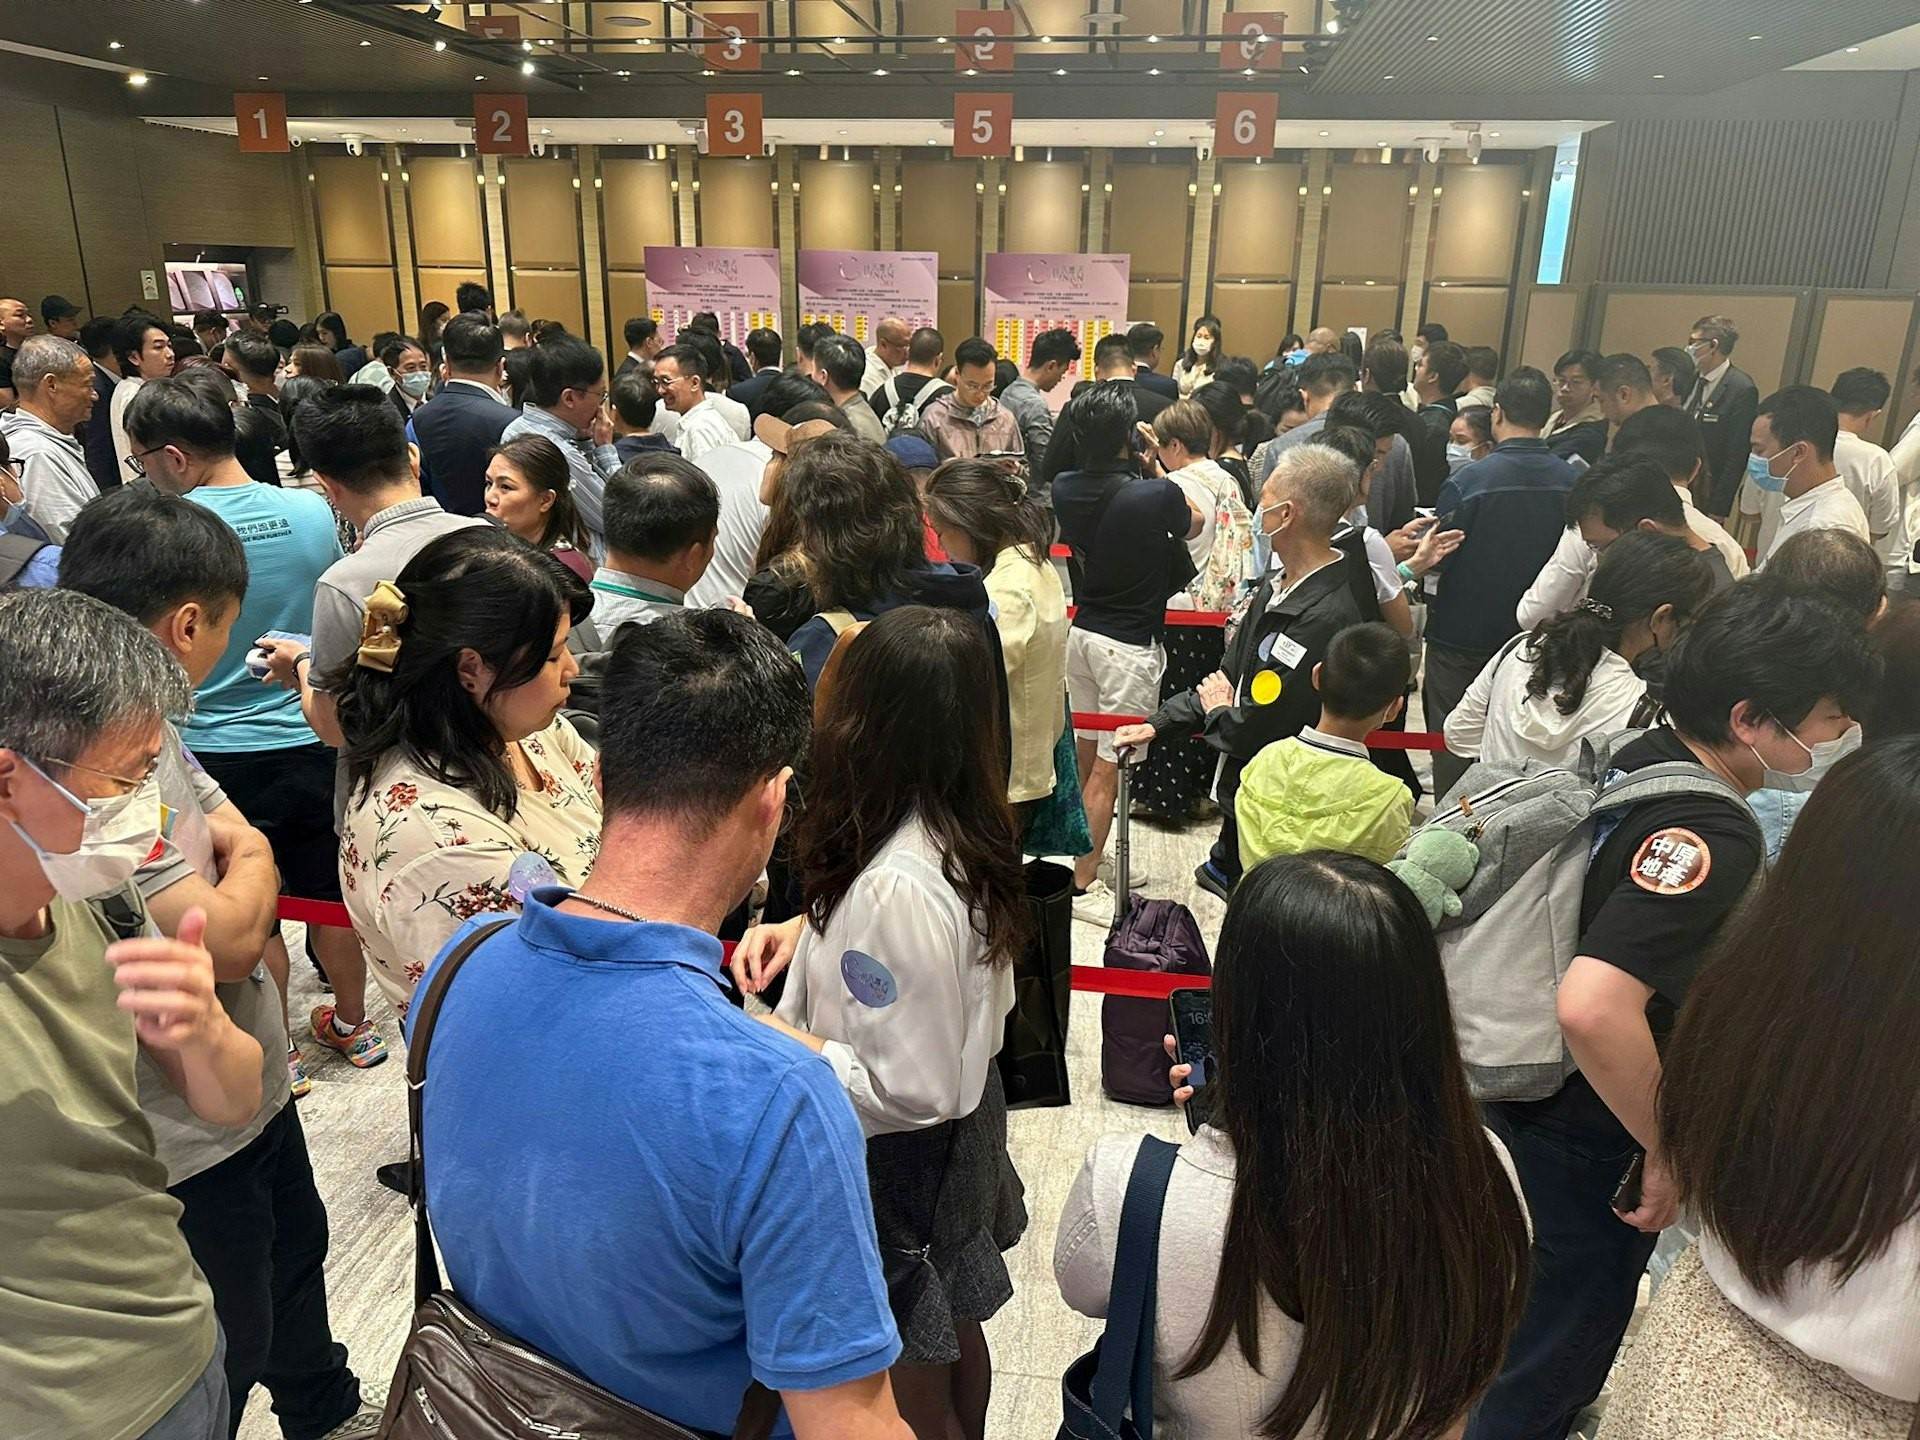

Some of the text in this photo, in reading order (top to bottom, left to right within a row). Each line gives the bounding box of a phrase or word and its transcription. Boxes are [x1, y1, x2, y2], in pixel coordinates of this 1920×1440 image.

[252, 108, 268, 139] 1
[491, 110, 512, 142] 2
[724, 109, 745, 143] 3
[971, 110, 993, 144] 5
[1233, 109, 1257, 145] 6
[1650, 836, 1701, 868] 中原
[1637, 856, 1689, 888] 地產
